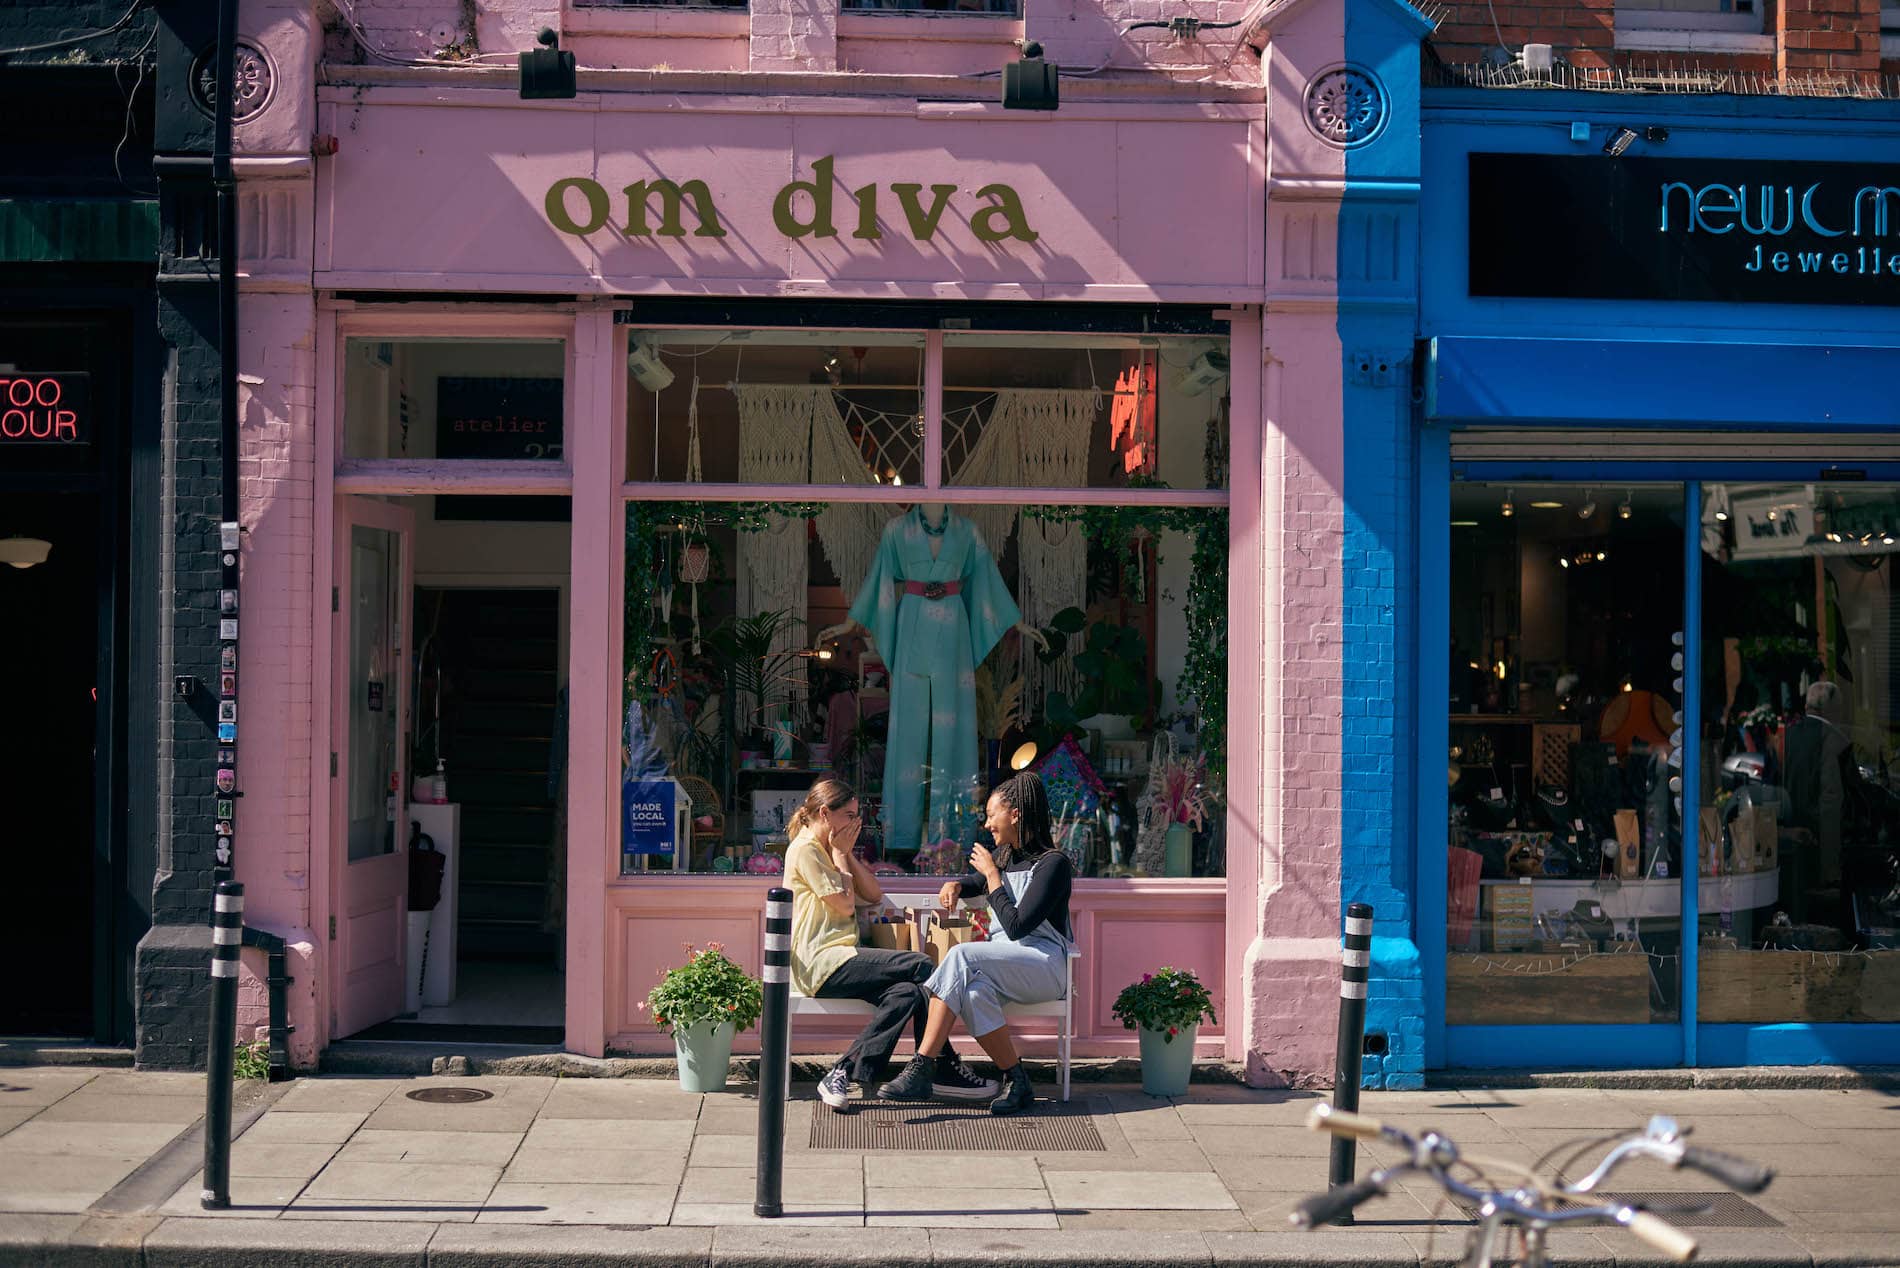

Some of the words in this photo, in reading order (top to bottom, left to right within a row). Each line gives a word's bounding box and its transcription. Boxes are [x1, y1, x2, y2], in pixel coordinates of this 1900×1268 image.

[544, 176, 728, 238] om
[772, 154, 1040, 243] diva
[1660, 181, 1794, 236] new
[0, 409, 77, 438] OUR
[453, 416, 547, 433] atelier
[632, 803, 662, 811] MADE
[632, 812, 665, 820] LOCAL
